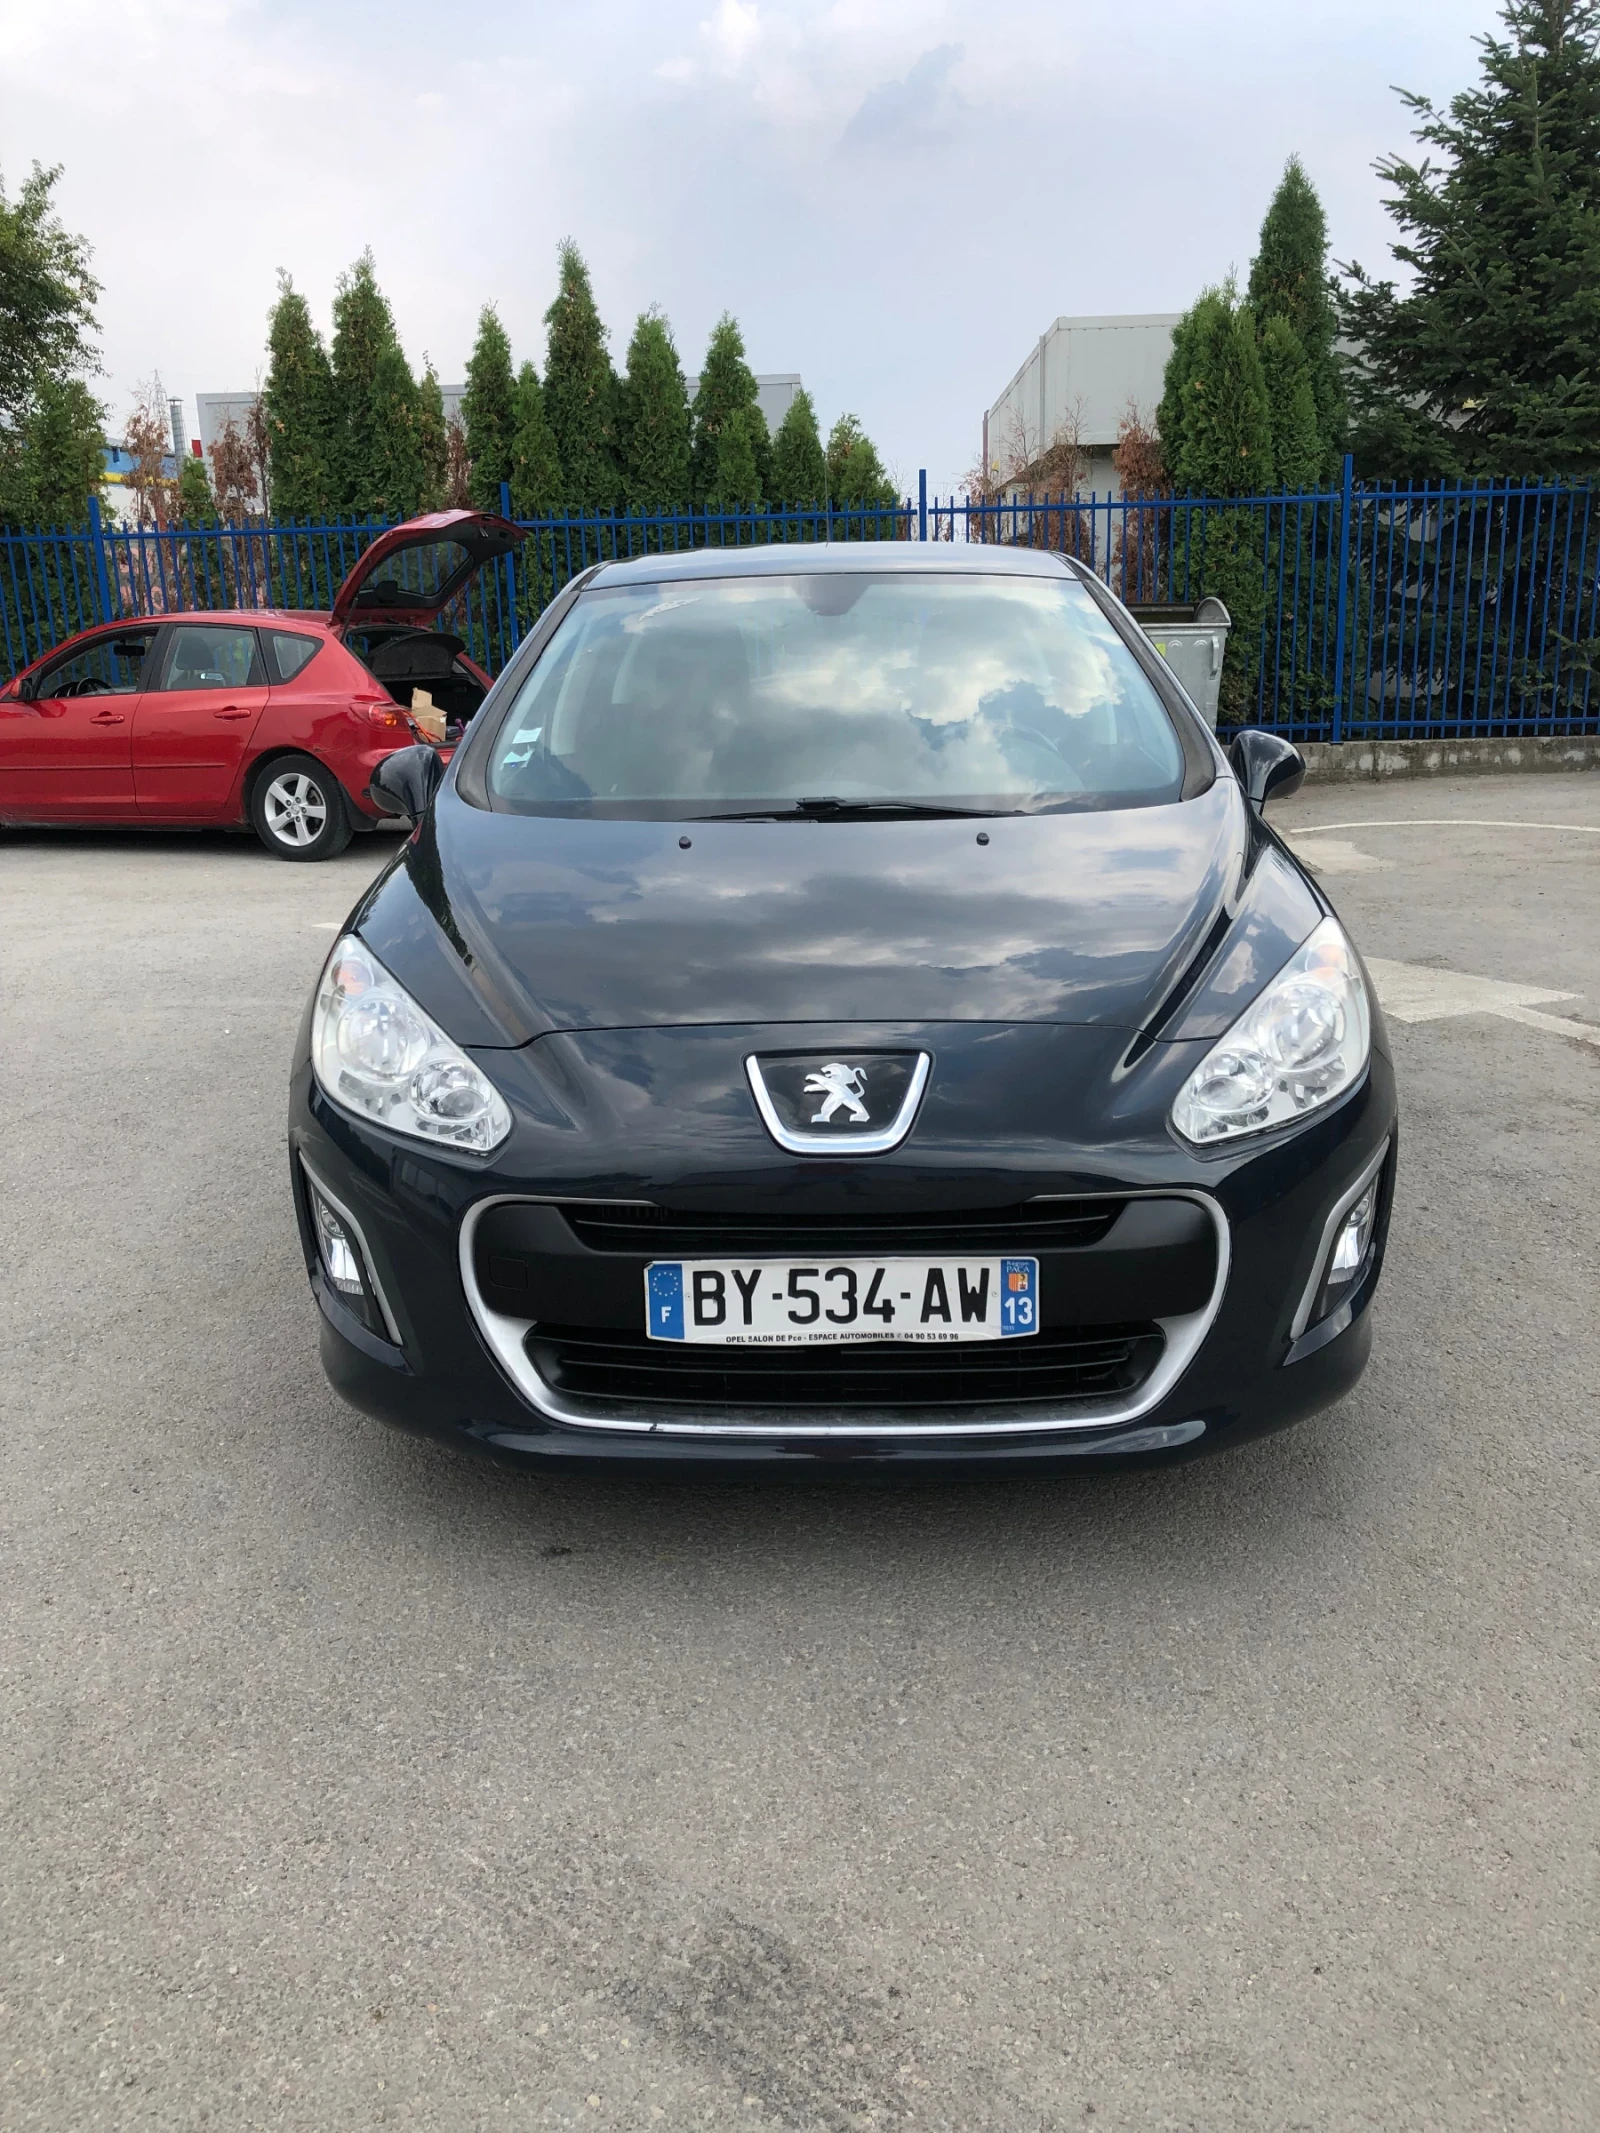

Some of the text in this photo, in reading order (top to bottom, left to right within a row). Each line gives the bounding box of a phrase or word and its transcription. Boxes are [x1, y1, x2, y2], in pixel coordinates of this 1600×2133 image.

[692, 1267, 990, 1326] BY-534-AW
[661, 1306, 672, 1323] F
[1004, 1297, 1032, 1324] 13
